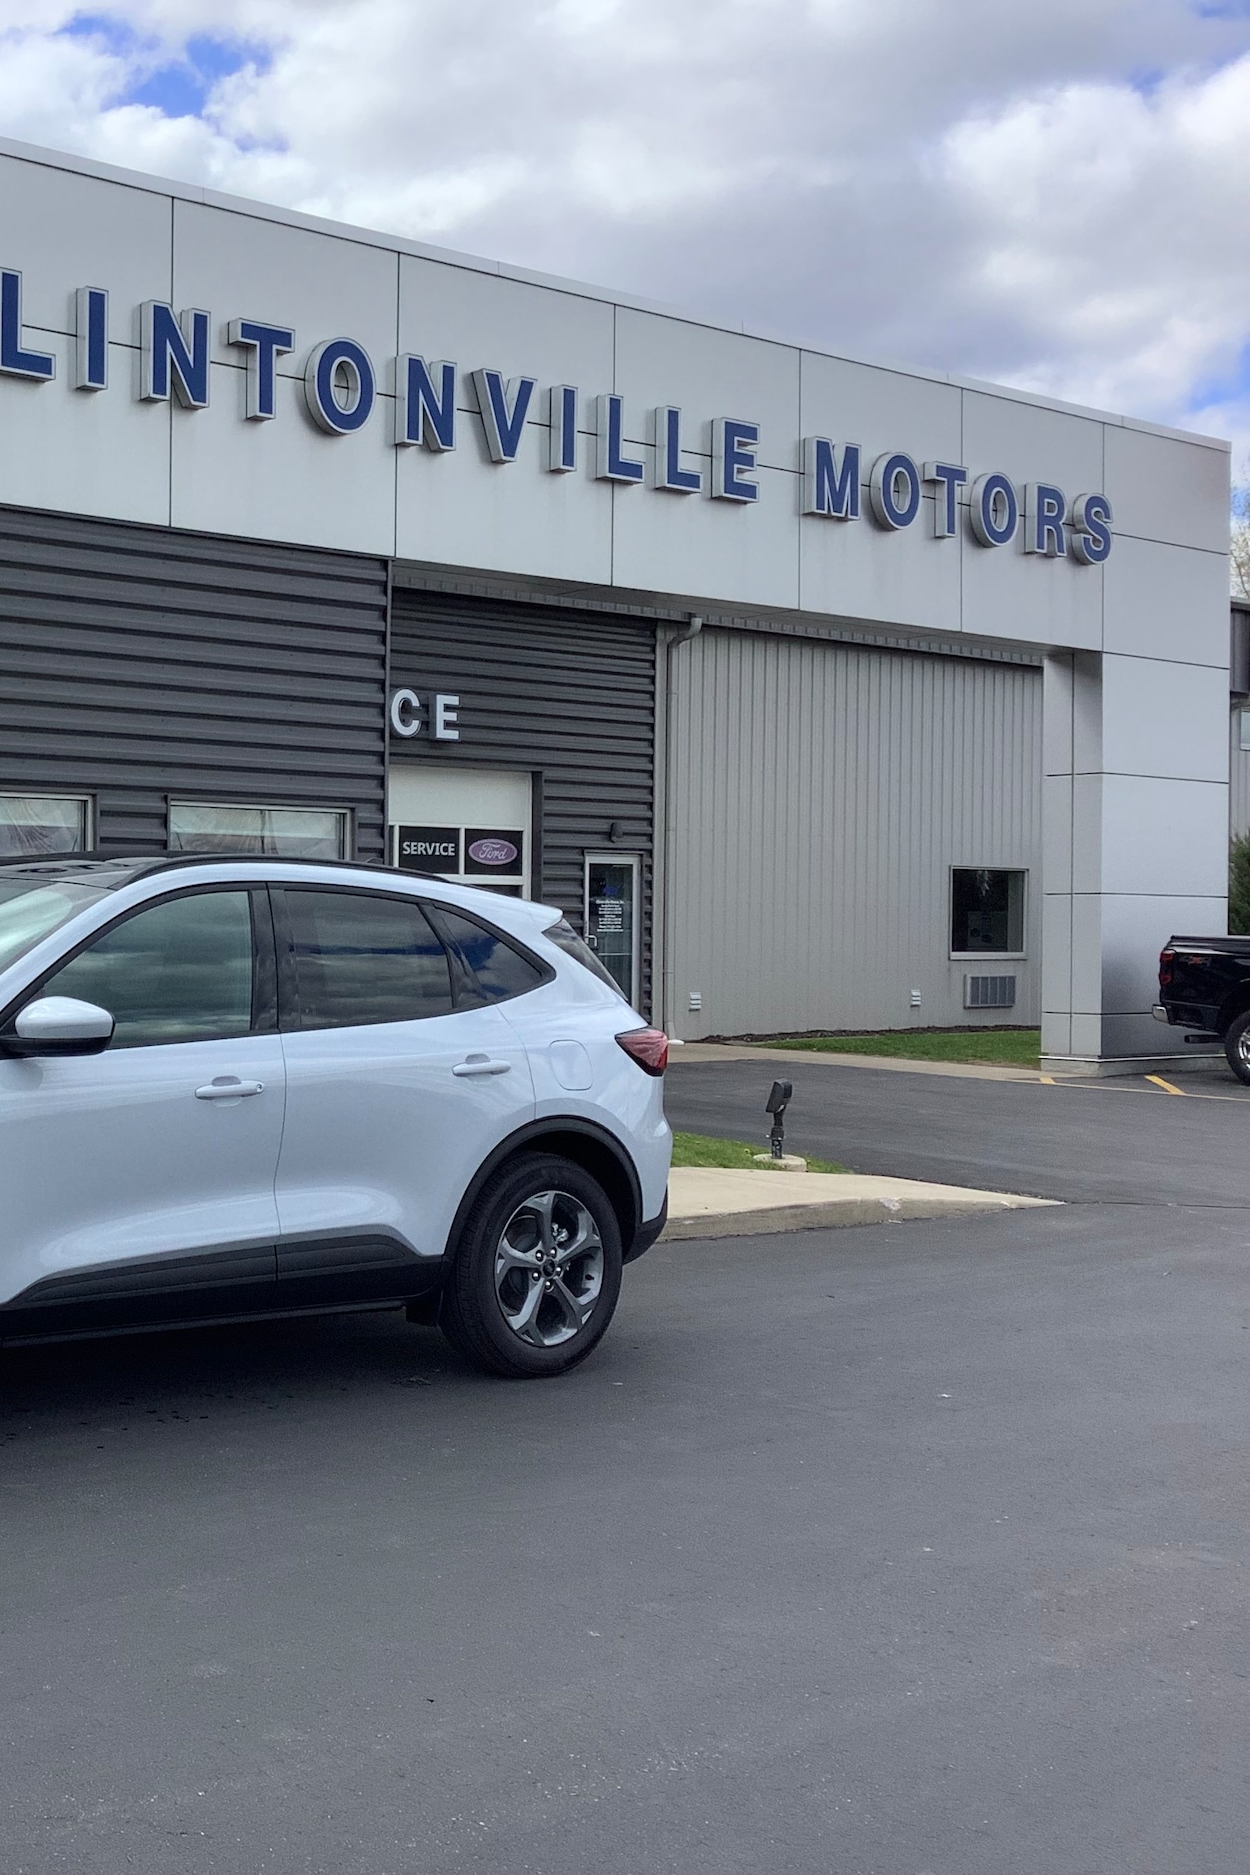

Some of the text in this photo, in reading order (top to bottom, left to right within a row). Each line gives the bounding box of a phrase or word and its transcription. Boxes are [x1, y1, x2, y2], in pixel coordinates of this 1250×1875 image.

[803, 436, 1114, 566] MOTORS
[402, 841, 456, 856] SERVICE
[478, 842, 508, 860] Ford
